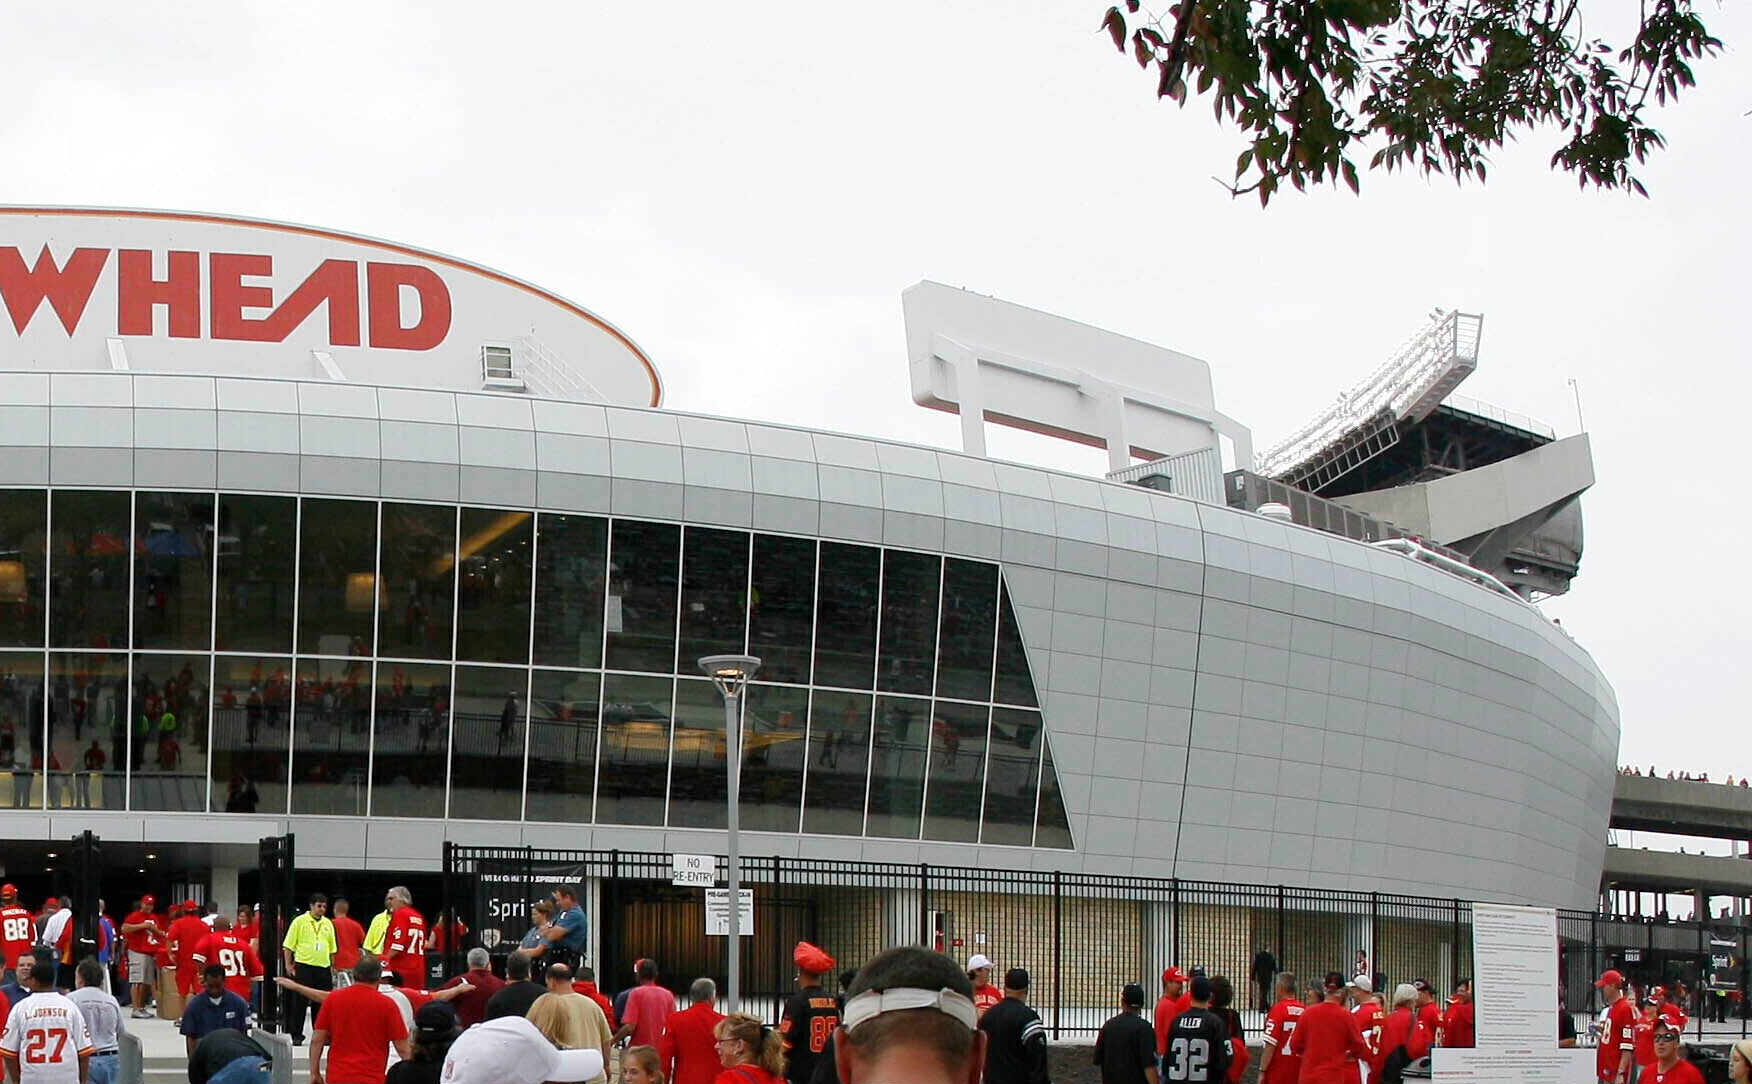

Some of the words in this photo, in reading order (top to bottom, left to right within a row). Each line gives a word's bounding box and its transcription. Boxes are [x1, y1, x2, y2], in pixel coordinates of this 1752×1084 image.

[688, 858, 700, 868] NO
[673, 871, 713, 882] RE-ENTRY
[3, 917, 30, 941] 88
[218, 948, 246, 978] 91
[24, 1006, 68, 1020] L.JOHNSON
[26, 1028, 68, 1064] 27
[1169, 1038, 1209, 1081] 32
